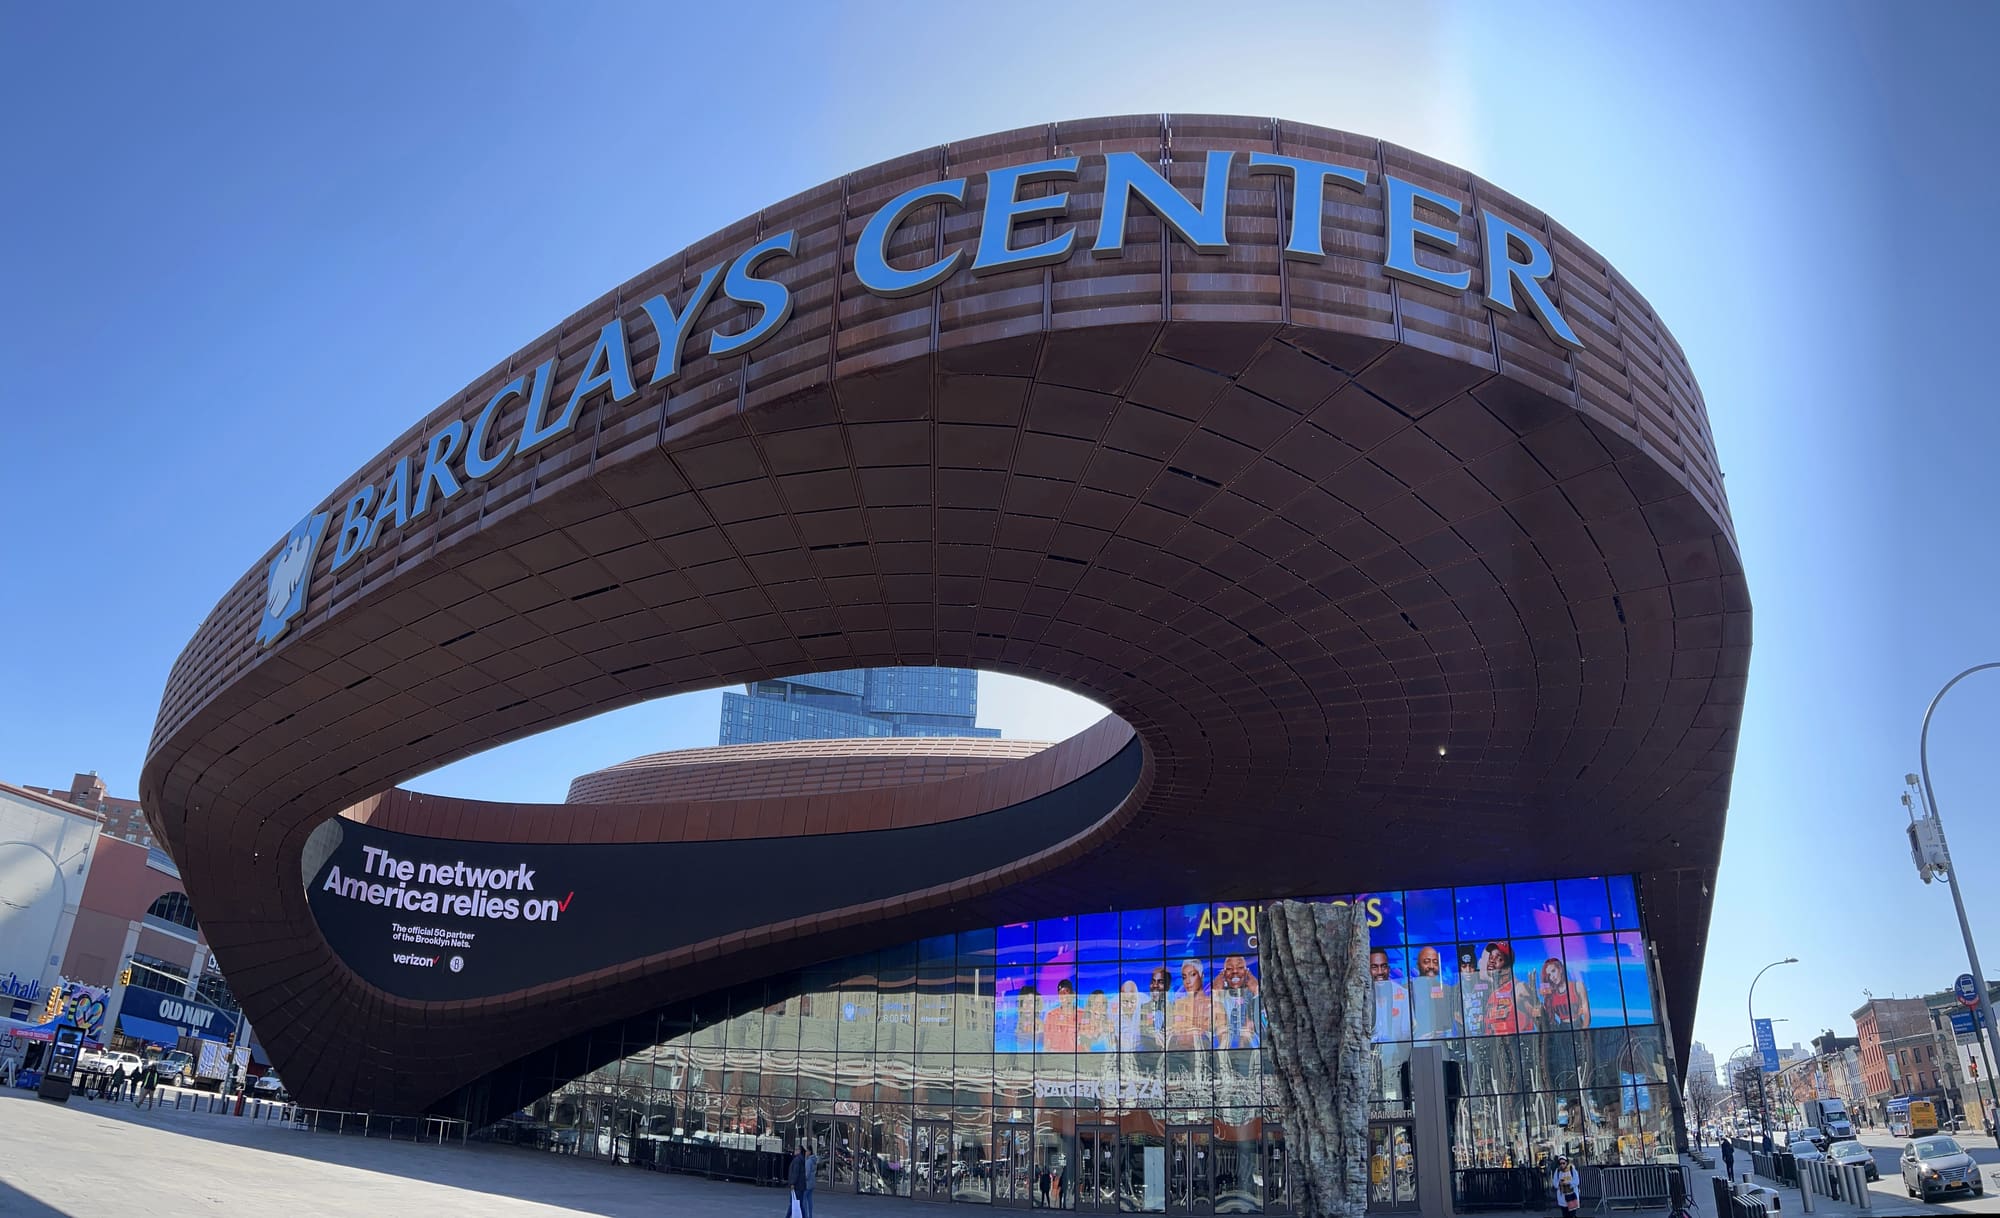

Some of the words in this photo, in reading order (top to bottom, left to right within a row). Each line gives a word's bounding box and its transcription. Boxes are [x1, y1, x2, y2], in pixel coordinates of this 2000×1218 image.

[330, 229, 798, 576] BARCLAYS
[853, 150, 1584, 351] CENTER
[362, 845, 415, 881] The
[418, 861, 536, 891] network
[323, 866, 438, 913] America
[441, 890, 520, 920] relies
[523, 899, 559, 921] on
[392, 923, 407, 933] The
[407, 926, 433, 936] official
[434, 928, 446, 937] 5G
[446, 931, 475, 940] partner
[1196, 905, 1262, 937] APRI
[392, 932, 402, 940] of
[402, 933, 414, 942] the
[415, 935, 450, 947] Brooklyn
[450, 940, 471, 948] Nets.
[393, 953, 433, 968] verizon
[1, 974, 41, 1000] shalls
[159, 999, 184, 1021] OLD
[182, 1005, 215, 1029] NAVY
[1102, 1079, 1164, 1100] PLAZA
[1370, 1110, 1390, 1120] MAIN
[1390, 1109, 1415, 1119] ENTR
